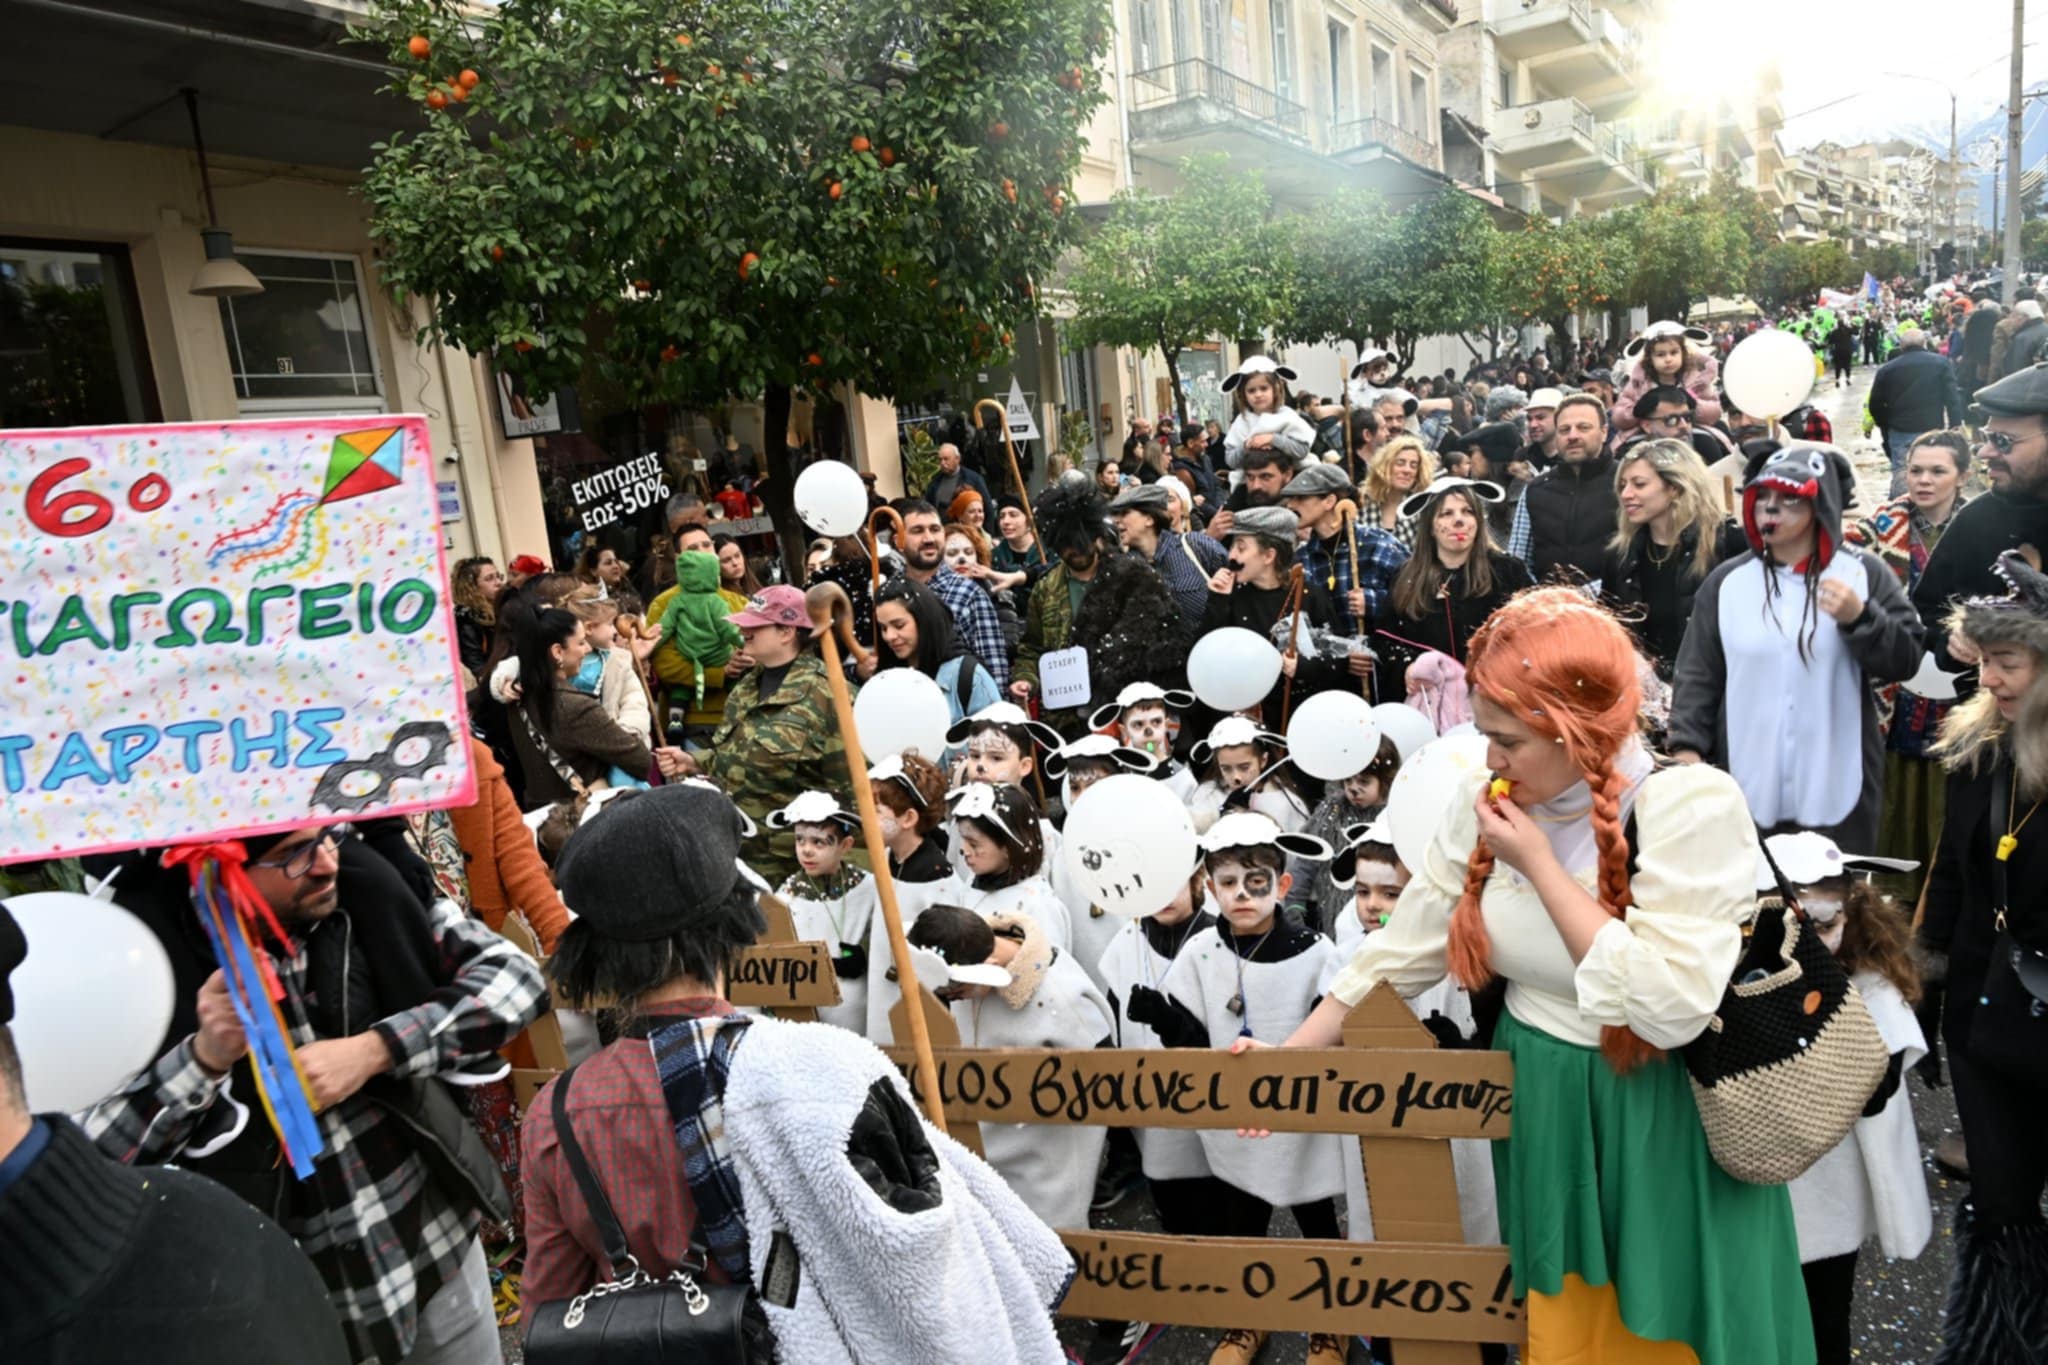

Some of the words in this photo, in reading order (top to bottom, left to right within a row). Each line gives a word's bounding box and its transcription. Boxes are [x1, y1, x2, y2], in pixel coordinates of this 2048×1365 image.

[571, 452, 662, 505] ΕΚΠΤΩΣΕΙΣ
[0, 578, 437, 658] ΙΑΓΩΓΕΙΟ
[1030, 1055, 1230, 1122] βγαίνει
